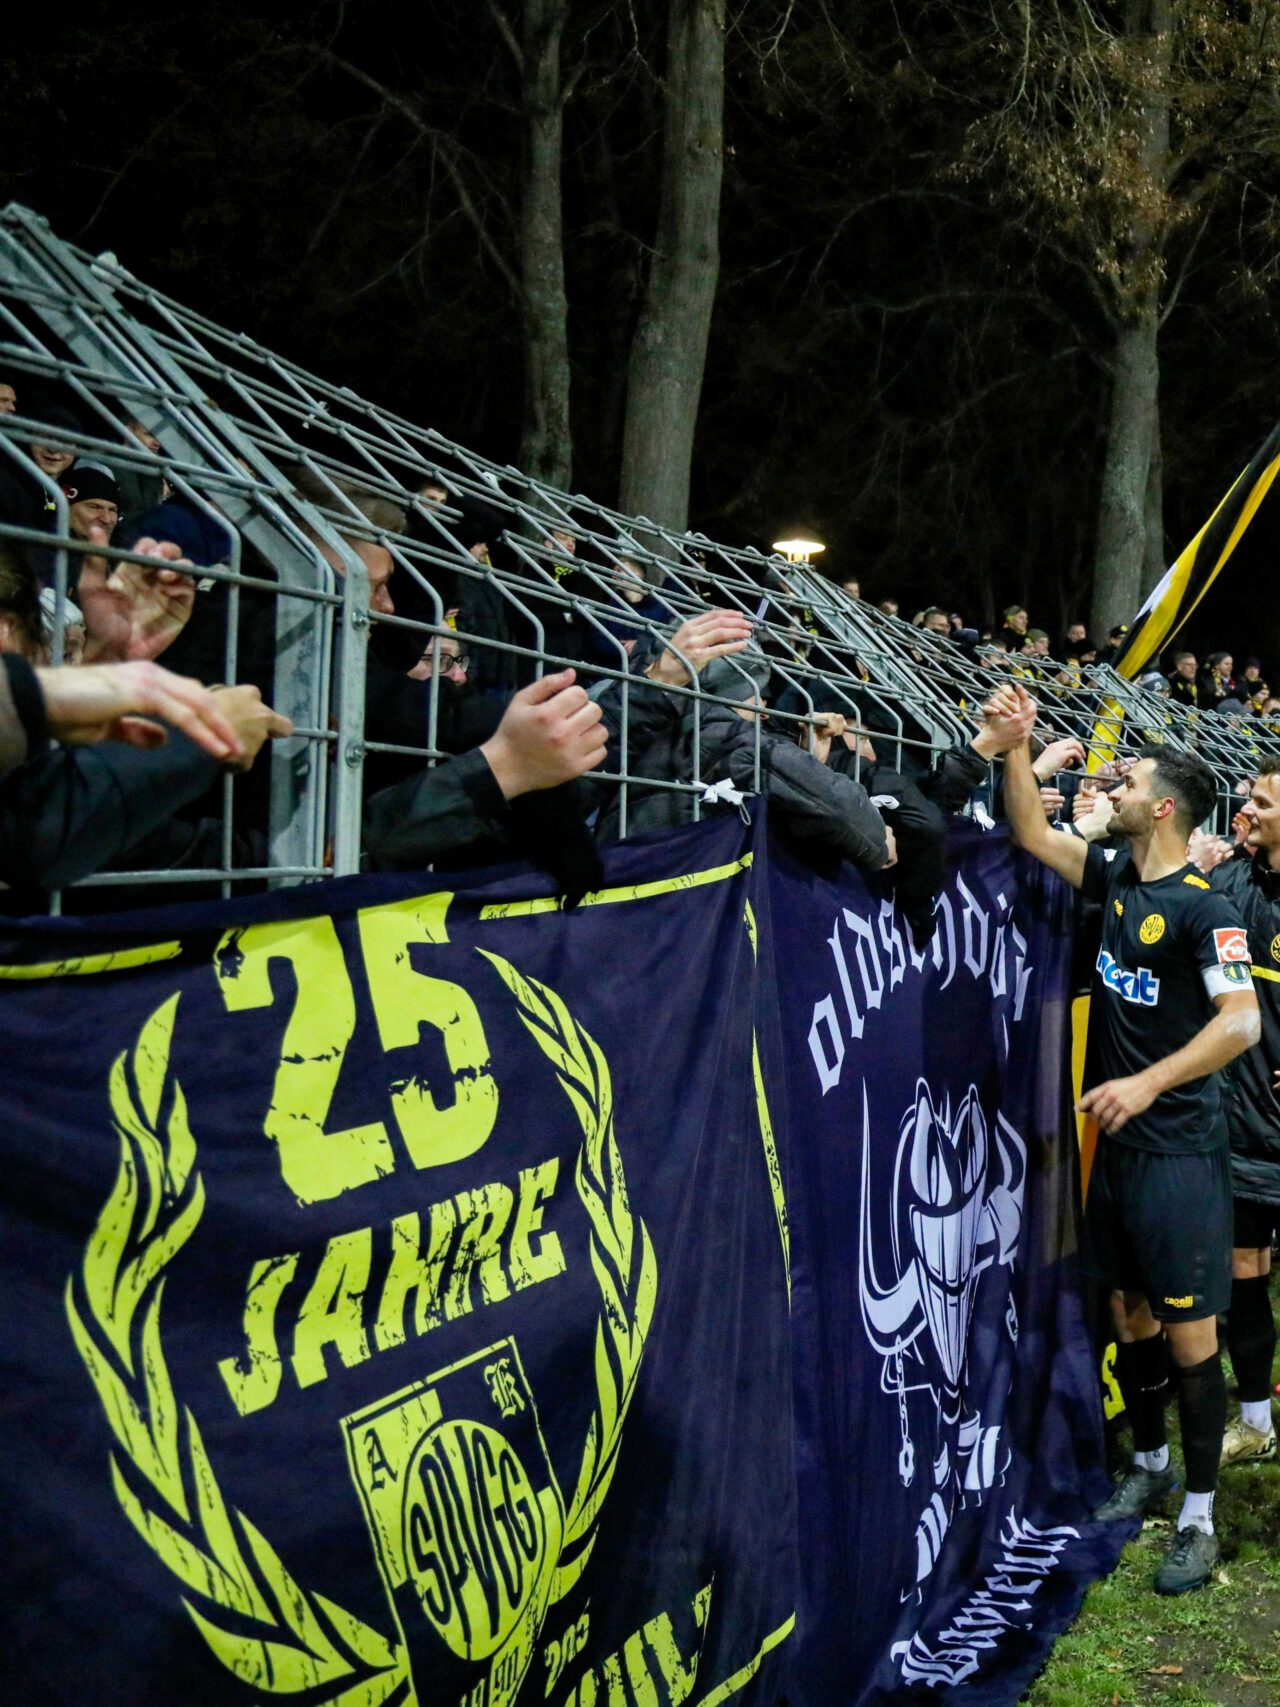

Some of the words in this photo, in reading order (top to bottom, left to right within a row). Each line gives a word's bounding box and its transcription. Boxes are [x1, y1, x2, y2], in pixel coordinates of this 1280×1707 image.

[213, 891, 500, 1208] 25
[217, 1158, 567, 1416] JAHRE
[1165, 1296, 1193, 1306] capelli
[410, 1425, 537, 1643] SPVGG
